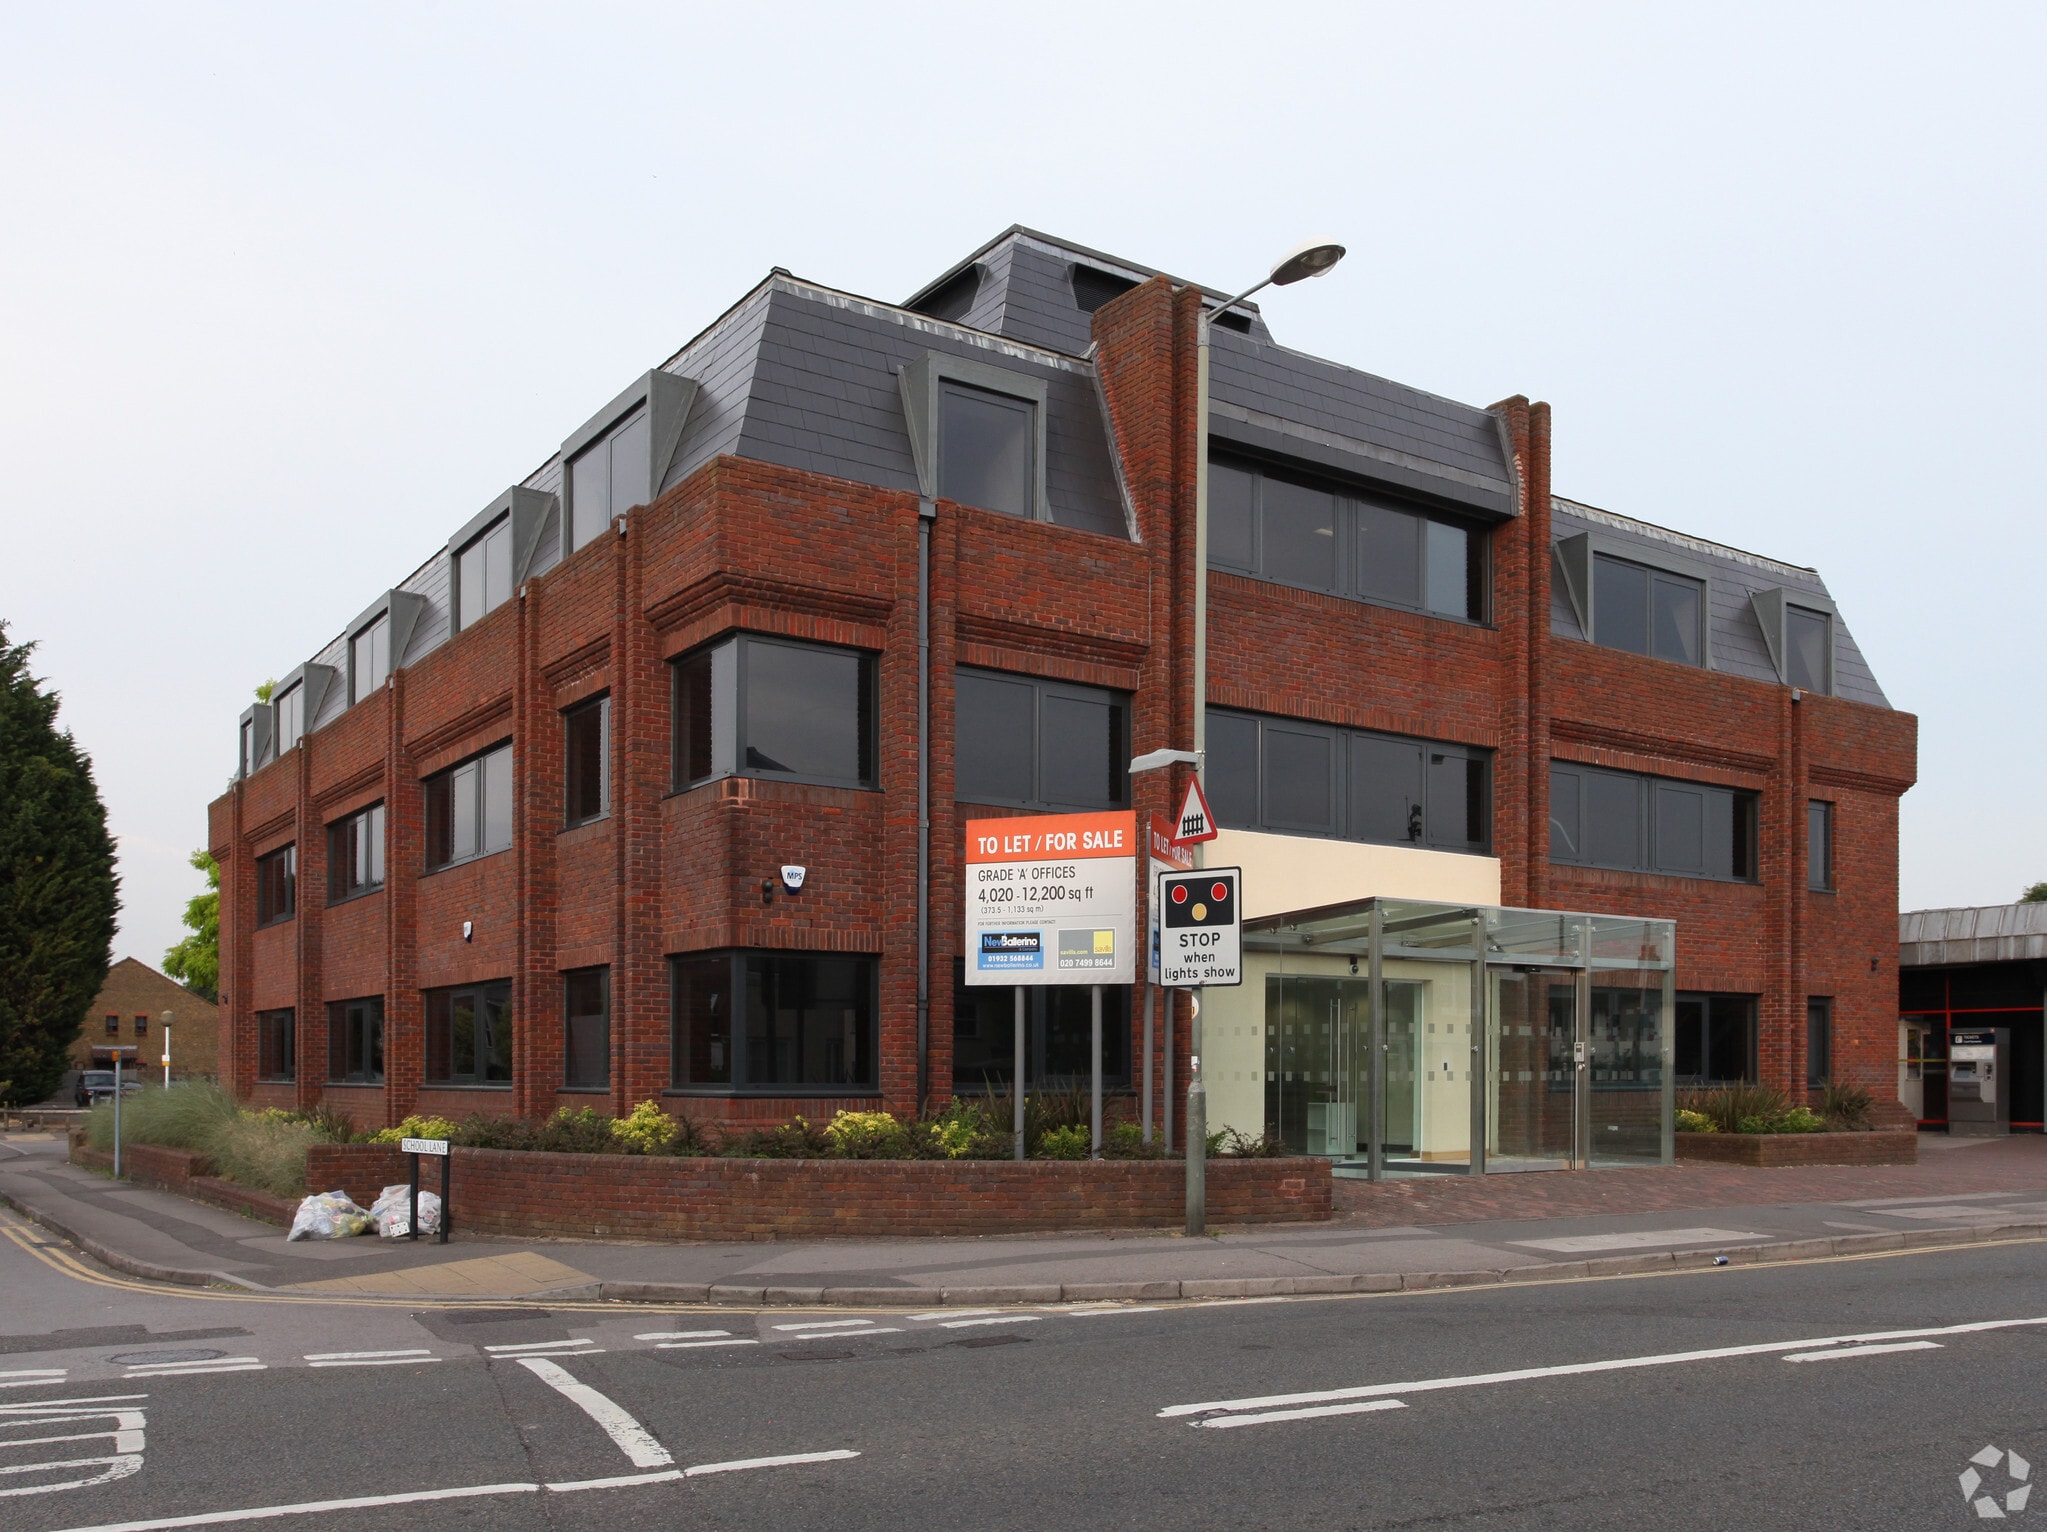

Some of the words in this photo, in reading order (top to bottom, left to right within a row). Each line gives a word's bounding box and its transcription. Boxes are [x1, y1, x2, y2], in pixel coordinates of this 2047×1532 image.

[978, 836, 998, 854] TO
[1003, 834, 1032, 854] LET
[1045, 832, 1077, 851] FOR
[1082, 829, 1123, 849] SALE
[1154, 831, 1160, 850] TO
[1160, 835, 1169, 856] LET
[1181, 847, 1192, 867] SALE
[786, 871, 803, 881] MPS
[978, 868, 1014, 882] GRADE
[1031, 865, 1076, 880] OFFICES
[978, 887, 1014, 904] 4,020
[1022, 885, 1066, 903] 12,200
[1068, 890, 1081, 902] sq
[1085, 886, 1094, 899] ft
[1007, 905, 1025, 914] 1,133
[1026, 906, 1034, 914] sq
[1035, 904, 1044, 913] m)
[1179, 932, 1221, 948] STOP
[1060, 959, 1074, 967] 020
[1075, 959, 1093, 967] 7499
[1094, 958, 1113, 967] 8644
[1183, 951, 1215, 963] when
[1164, 967, 1199, 981] lights
[1203, 966, 1235, 978] show
[403, 1139, 427, 1151] SCHOOL
[429, 1141, 446, 1153] LANE
